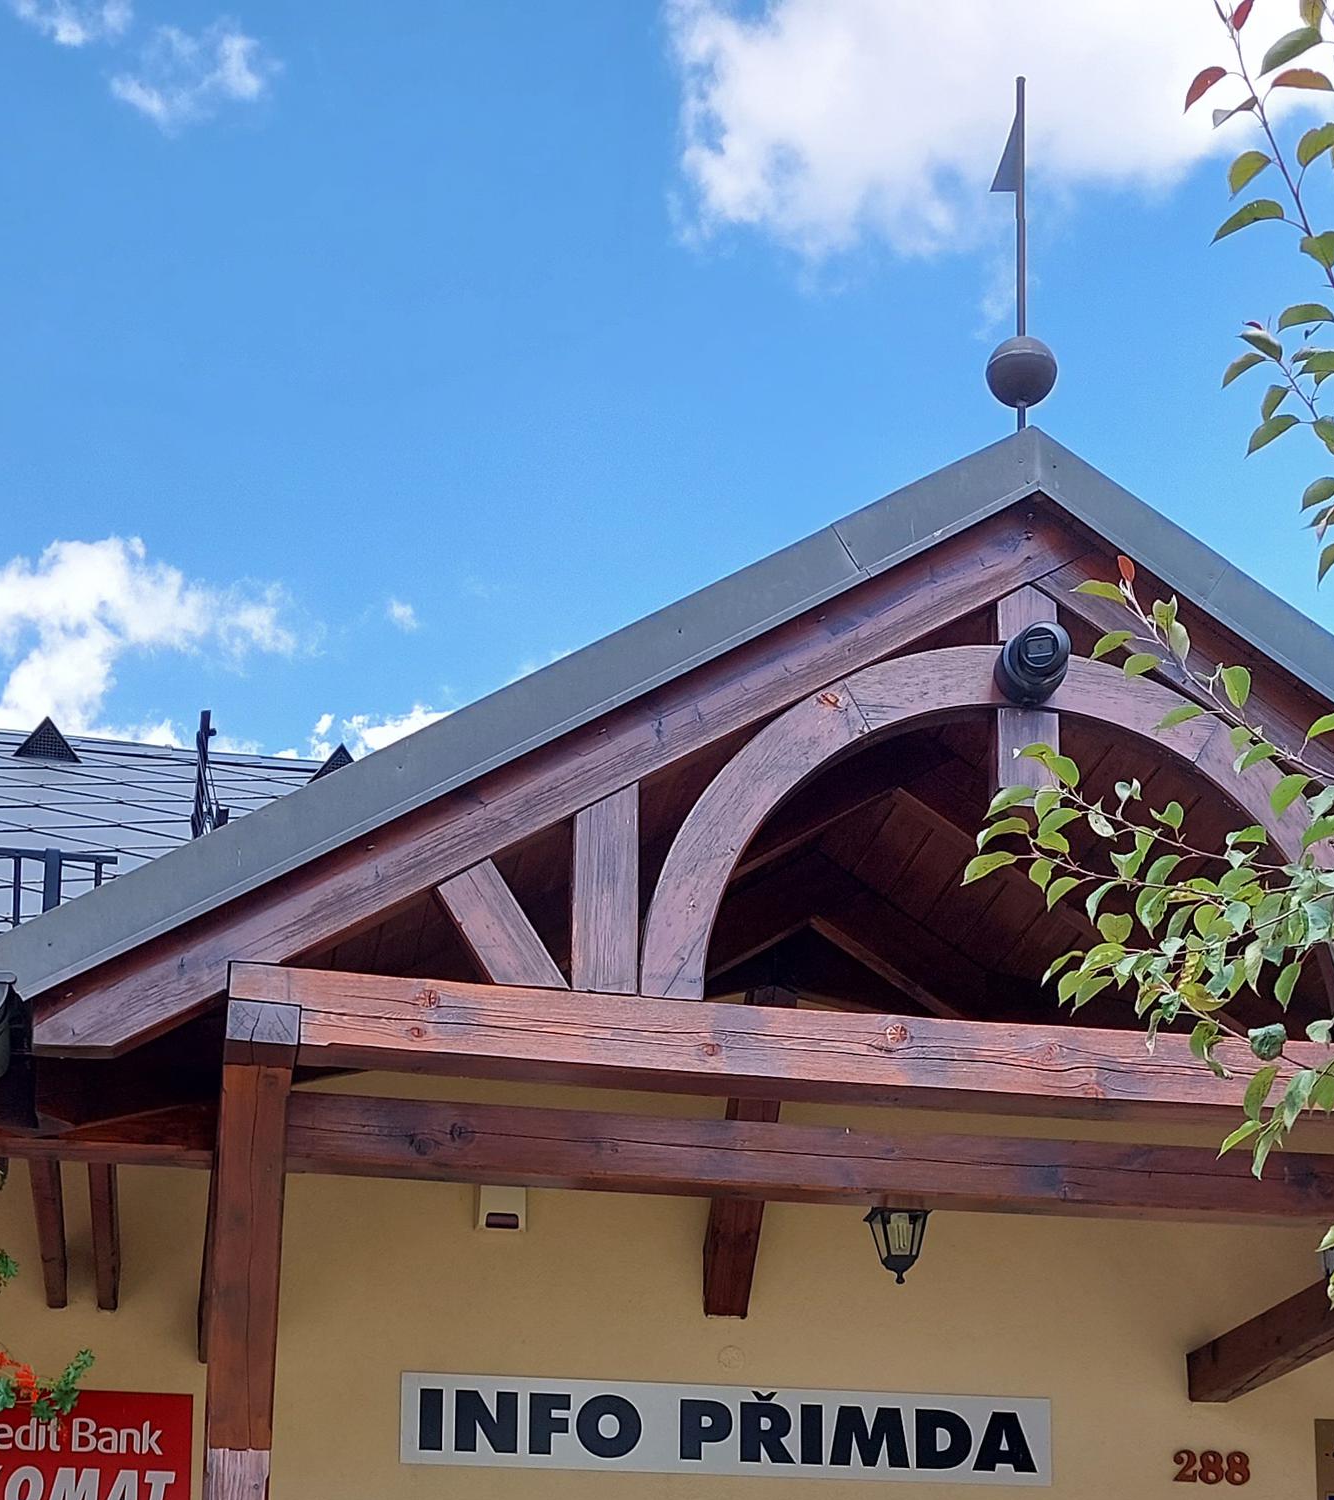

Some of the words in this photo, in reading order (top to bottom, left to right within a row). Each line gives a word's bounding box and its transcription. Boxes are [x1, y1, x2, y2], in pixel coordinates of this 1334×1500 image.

[71, 1417, 164, 1456] Bank
[418, 1388, 644, 1460] INFO
[679, 1391, 1038, 1474] PŘIMDA
[1172, 1449, 1250, 1485] 288
